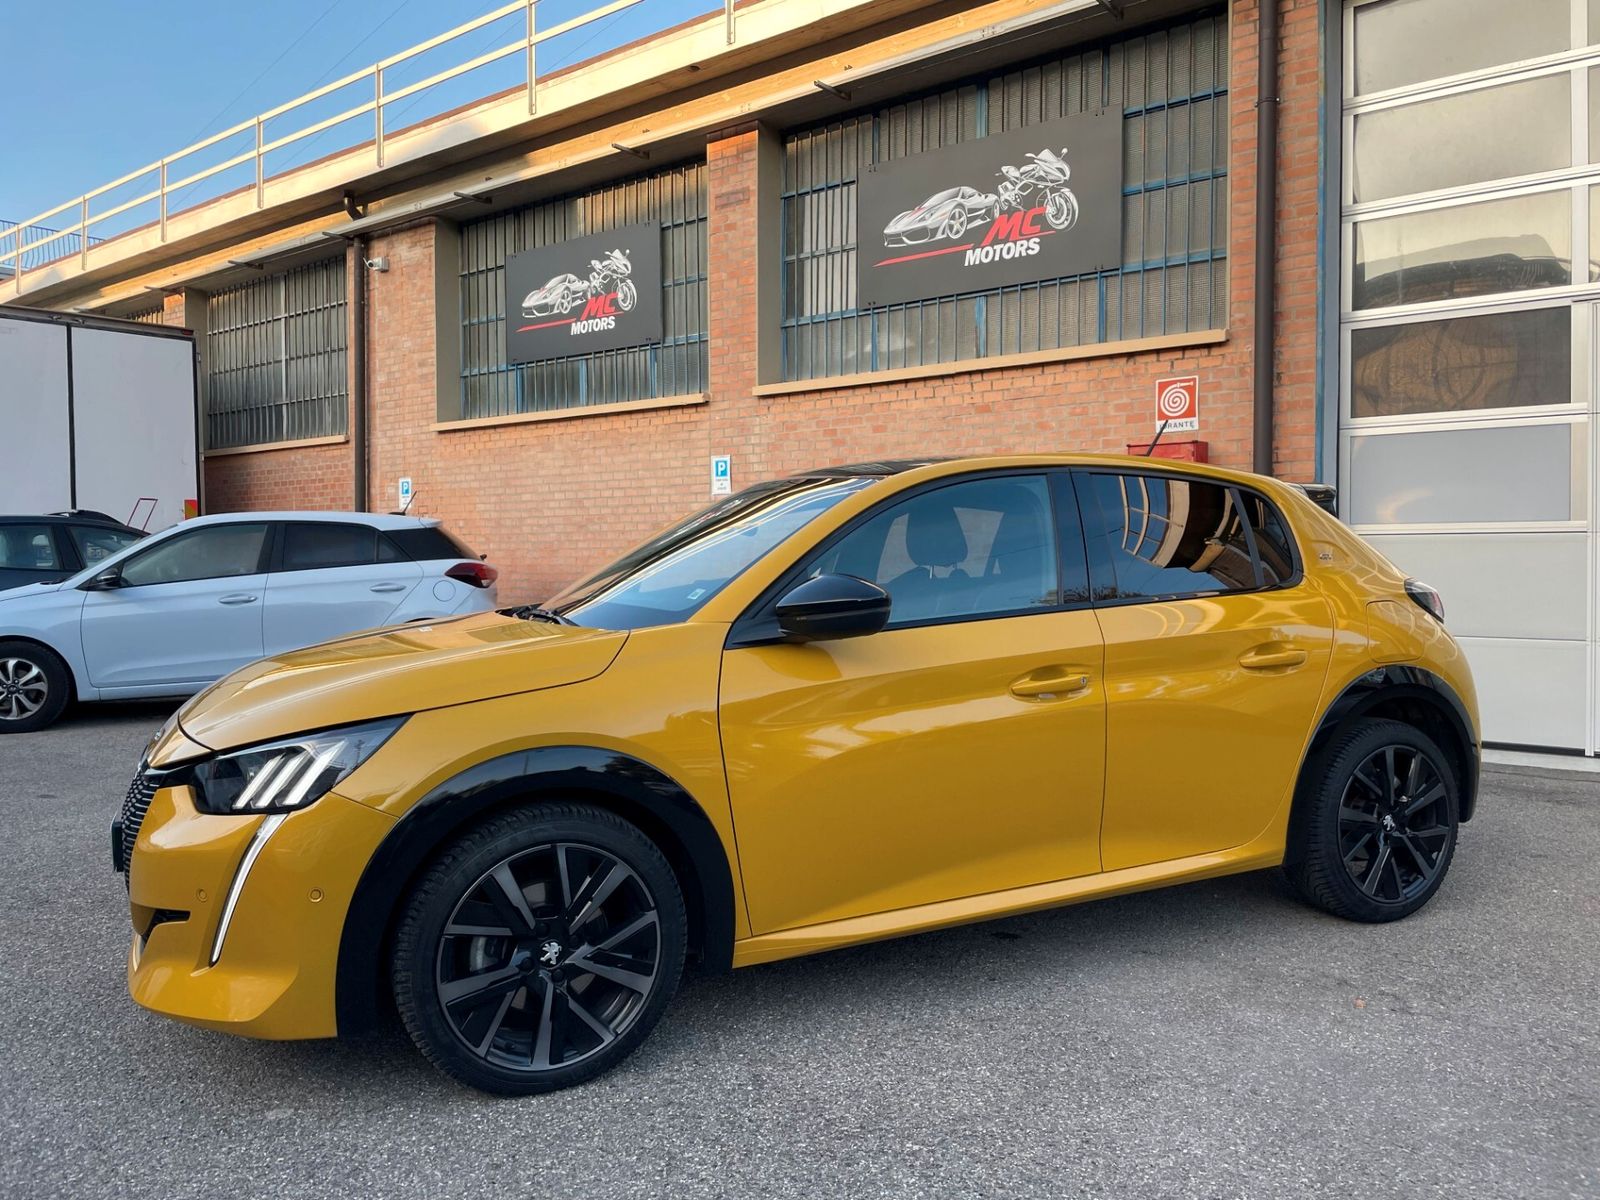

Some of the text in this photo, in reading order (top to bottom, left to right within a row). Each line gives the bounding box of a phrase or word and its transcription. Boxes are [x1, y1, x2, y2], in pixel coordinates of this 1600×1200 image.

[981, 206, 1047, 247] MC
[964, 237, 1041, 267] MOTORS
[580, 292, 619, 320] MC
[570, 315, 616, 336] MOTORS
